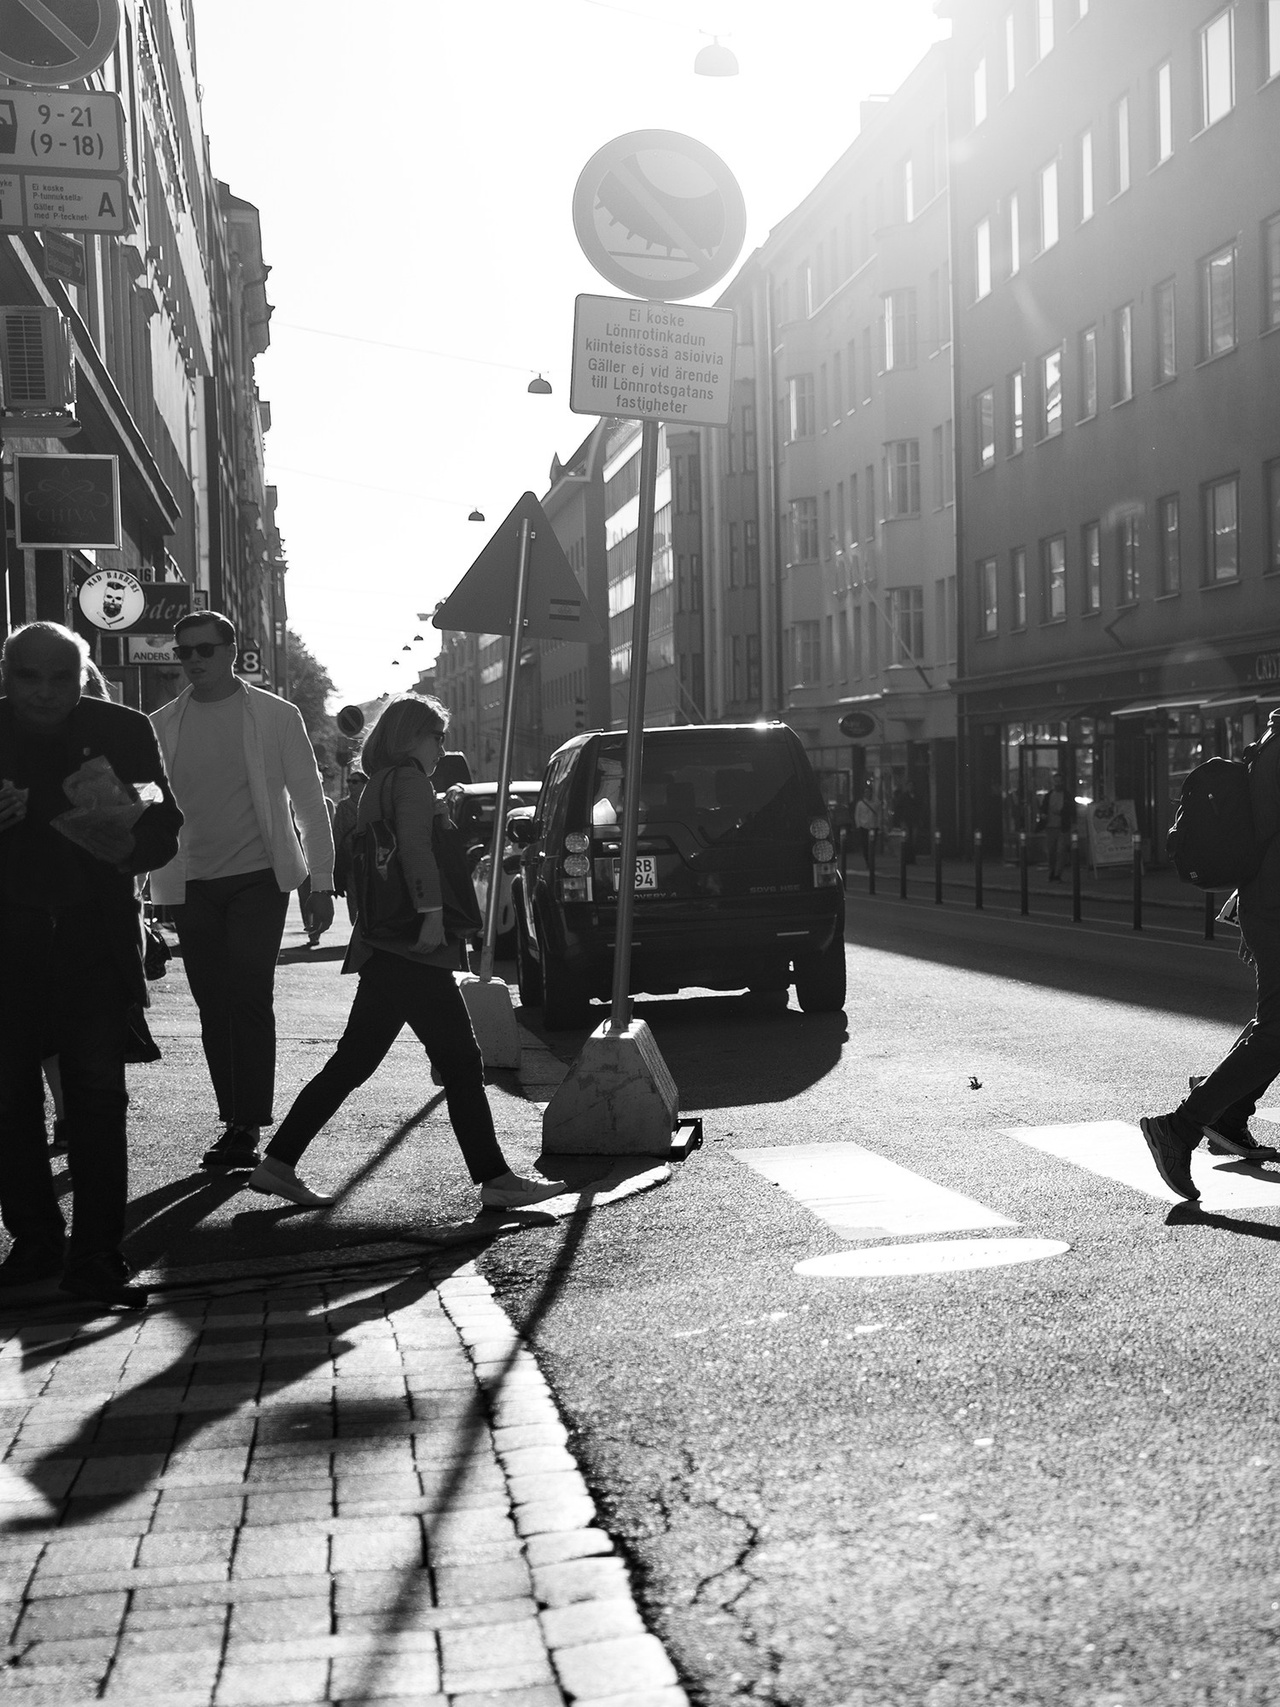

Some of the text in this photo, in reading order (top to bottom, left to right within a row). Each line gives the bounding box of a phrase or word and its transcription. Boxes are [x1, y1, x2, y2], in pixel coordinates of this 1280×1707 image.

[71, 106, 92, 127] 21
[32, 183, 64, 192] Ei koske
[58, 204, 65, 213] ej
[97, 192, 117, 217] A
[34, 212, 50, 220] med
[629, 308, 685, 327] Ei koske
[606, 323, 706, 347] Lönnrotinkadun
[586, 337, 724, 366] kiinteistössä asioivia
[588, 358, 719, 384] Gäller ej vid ärende
[591, 375, 714, 401] till Lönnrotsgatans
[616, 395, 688, 414] fastigheter
[86, 572, 140, 593] MAD BARBERS
[133, 652, 171, 661] ANDERS
[635, 859, 653, 873] RB
[635, 873, 654, 887] 94
